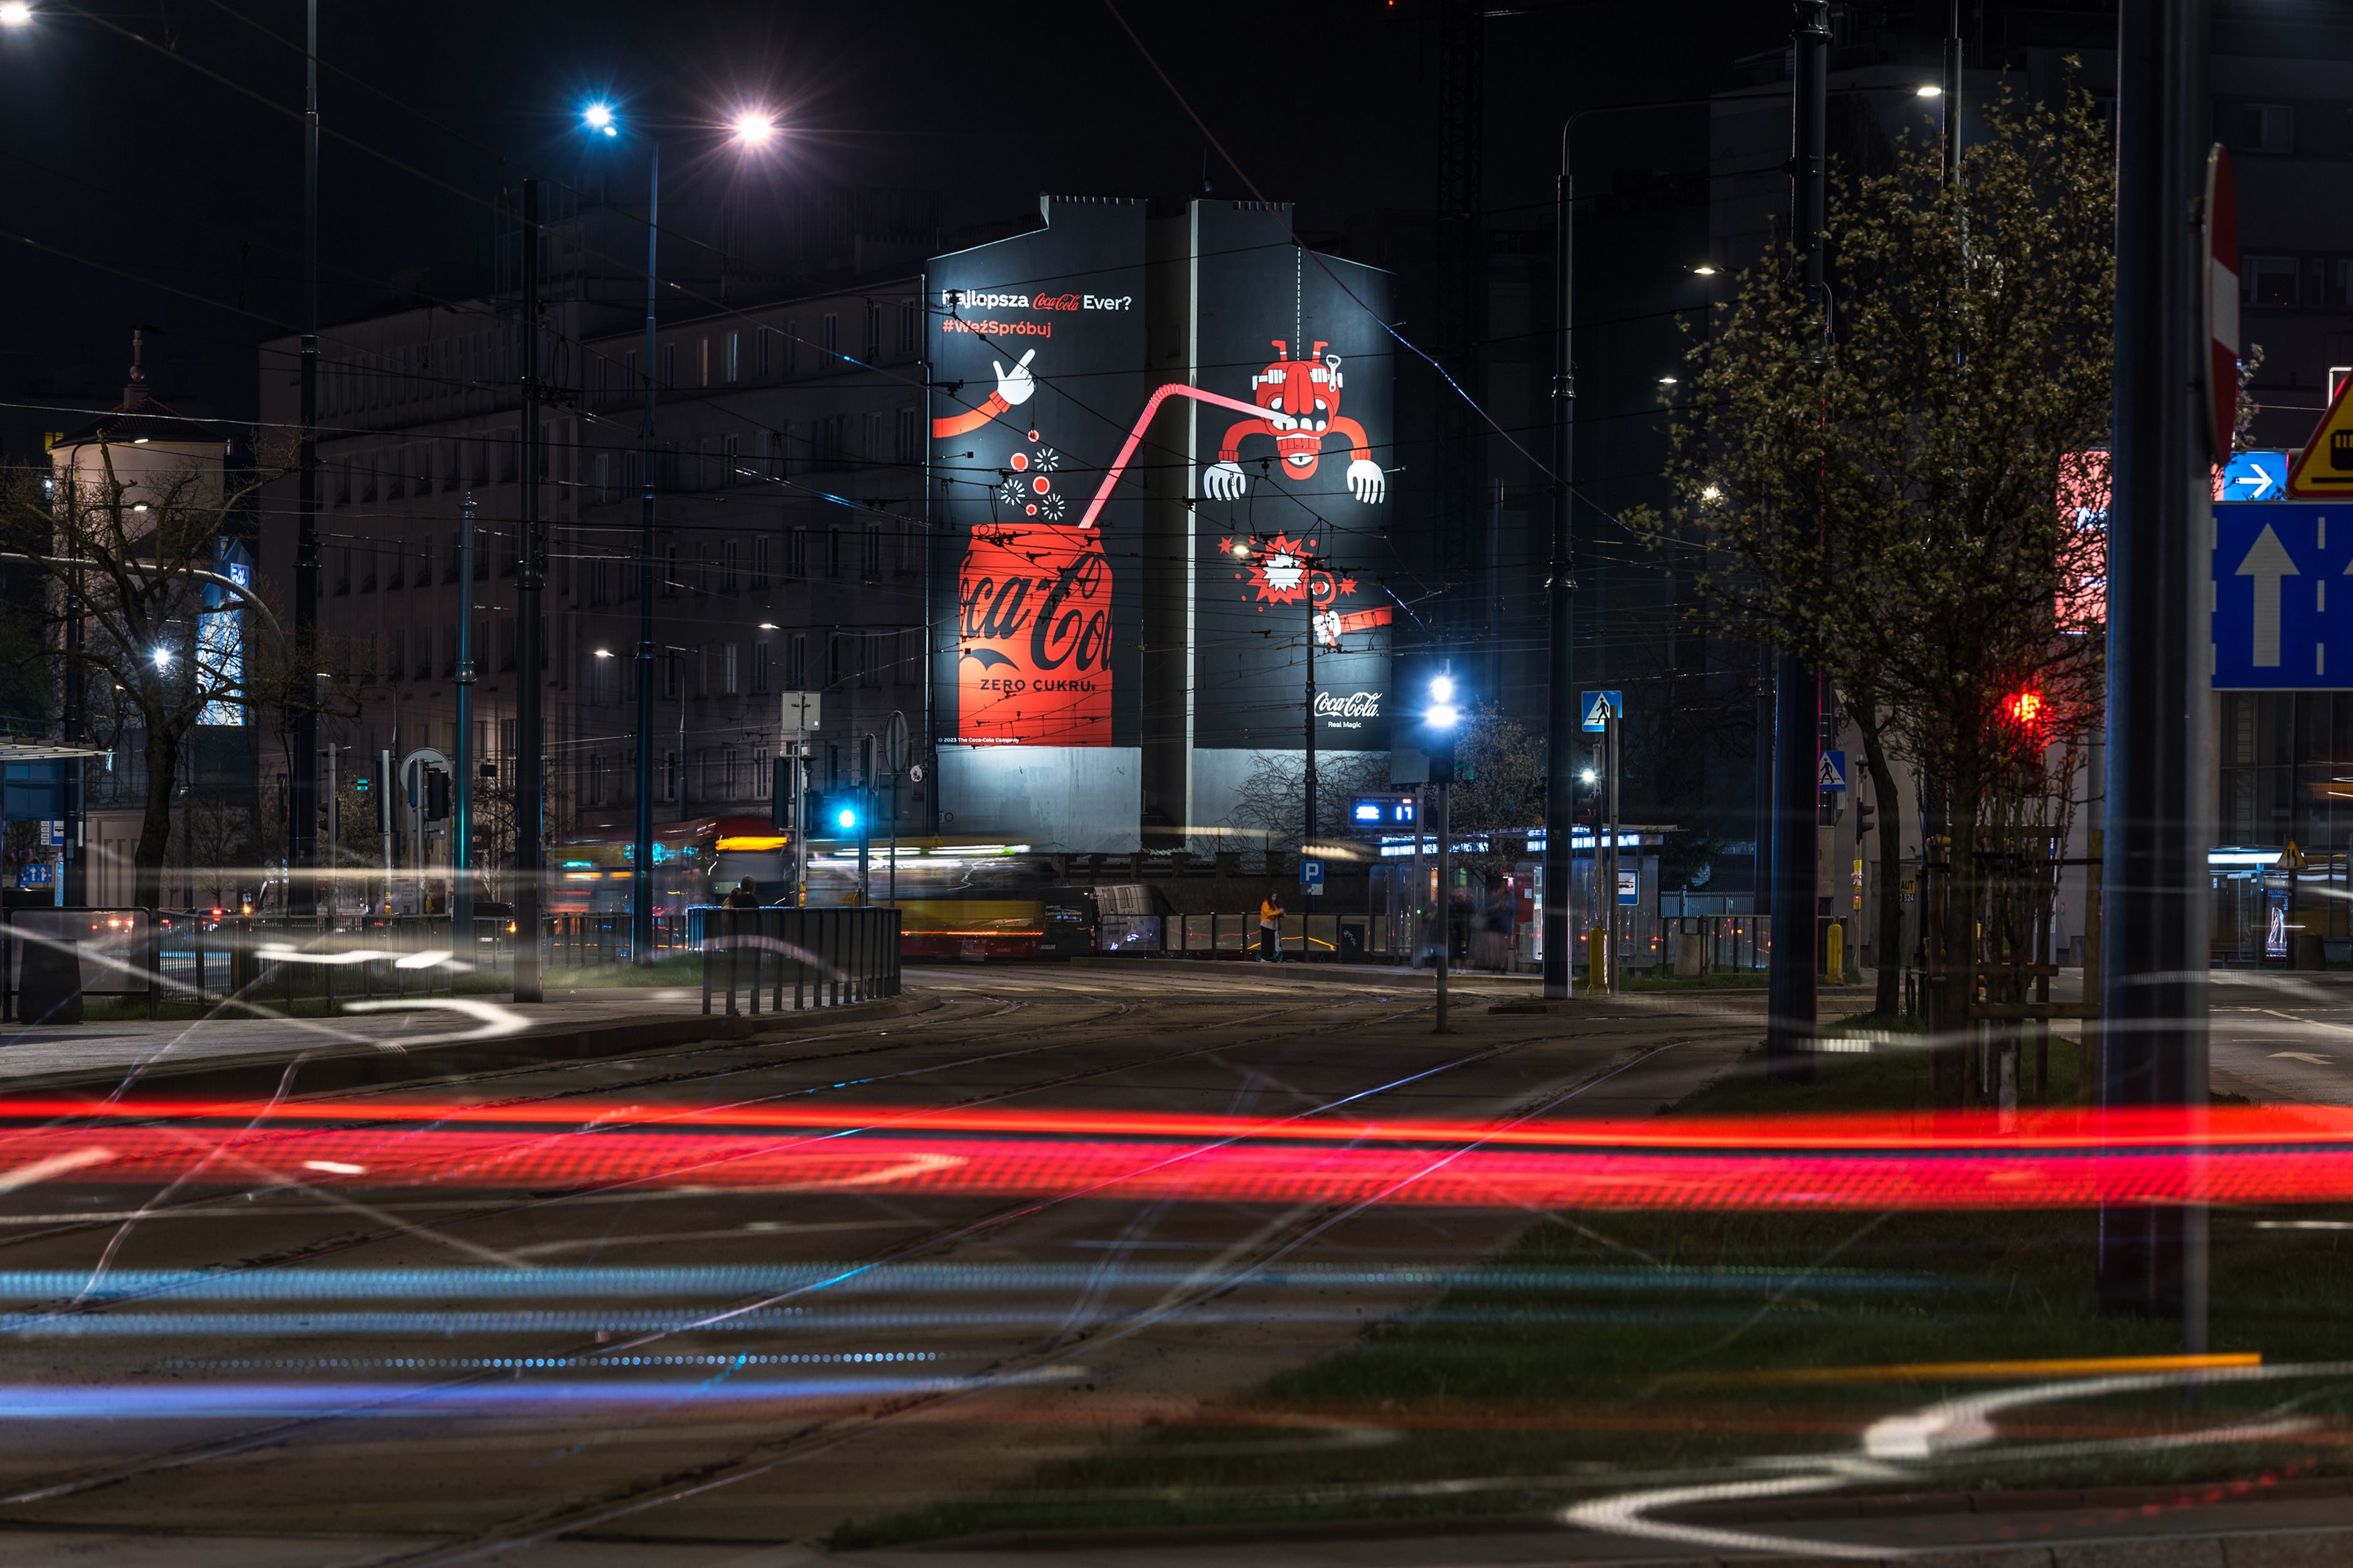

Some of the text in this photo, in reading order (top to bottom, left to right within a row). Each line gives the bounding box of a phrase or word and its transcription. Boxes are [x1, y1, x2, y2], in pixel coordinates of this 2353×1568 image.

[1033, 292, 1082, 311] Coca-Cola
[1083, 294, 1132, 311] Ever?
[942, 319, 1052, 338] #WeźSpróbuj
[981, 679, 1091, 691] ZERO CUKRU
[1315, 692, 1382, 717] Coca-Cola
[1305, 863, 1319, 882] P
[1900, 880, 1914, 890] AUT
